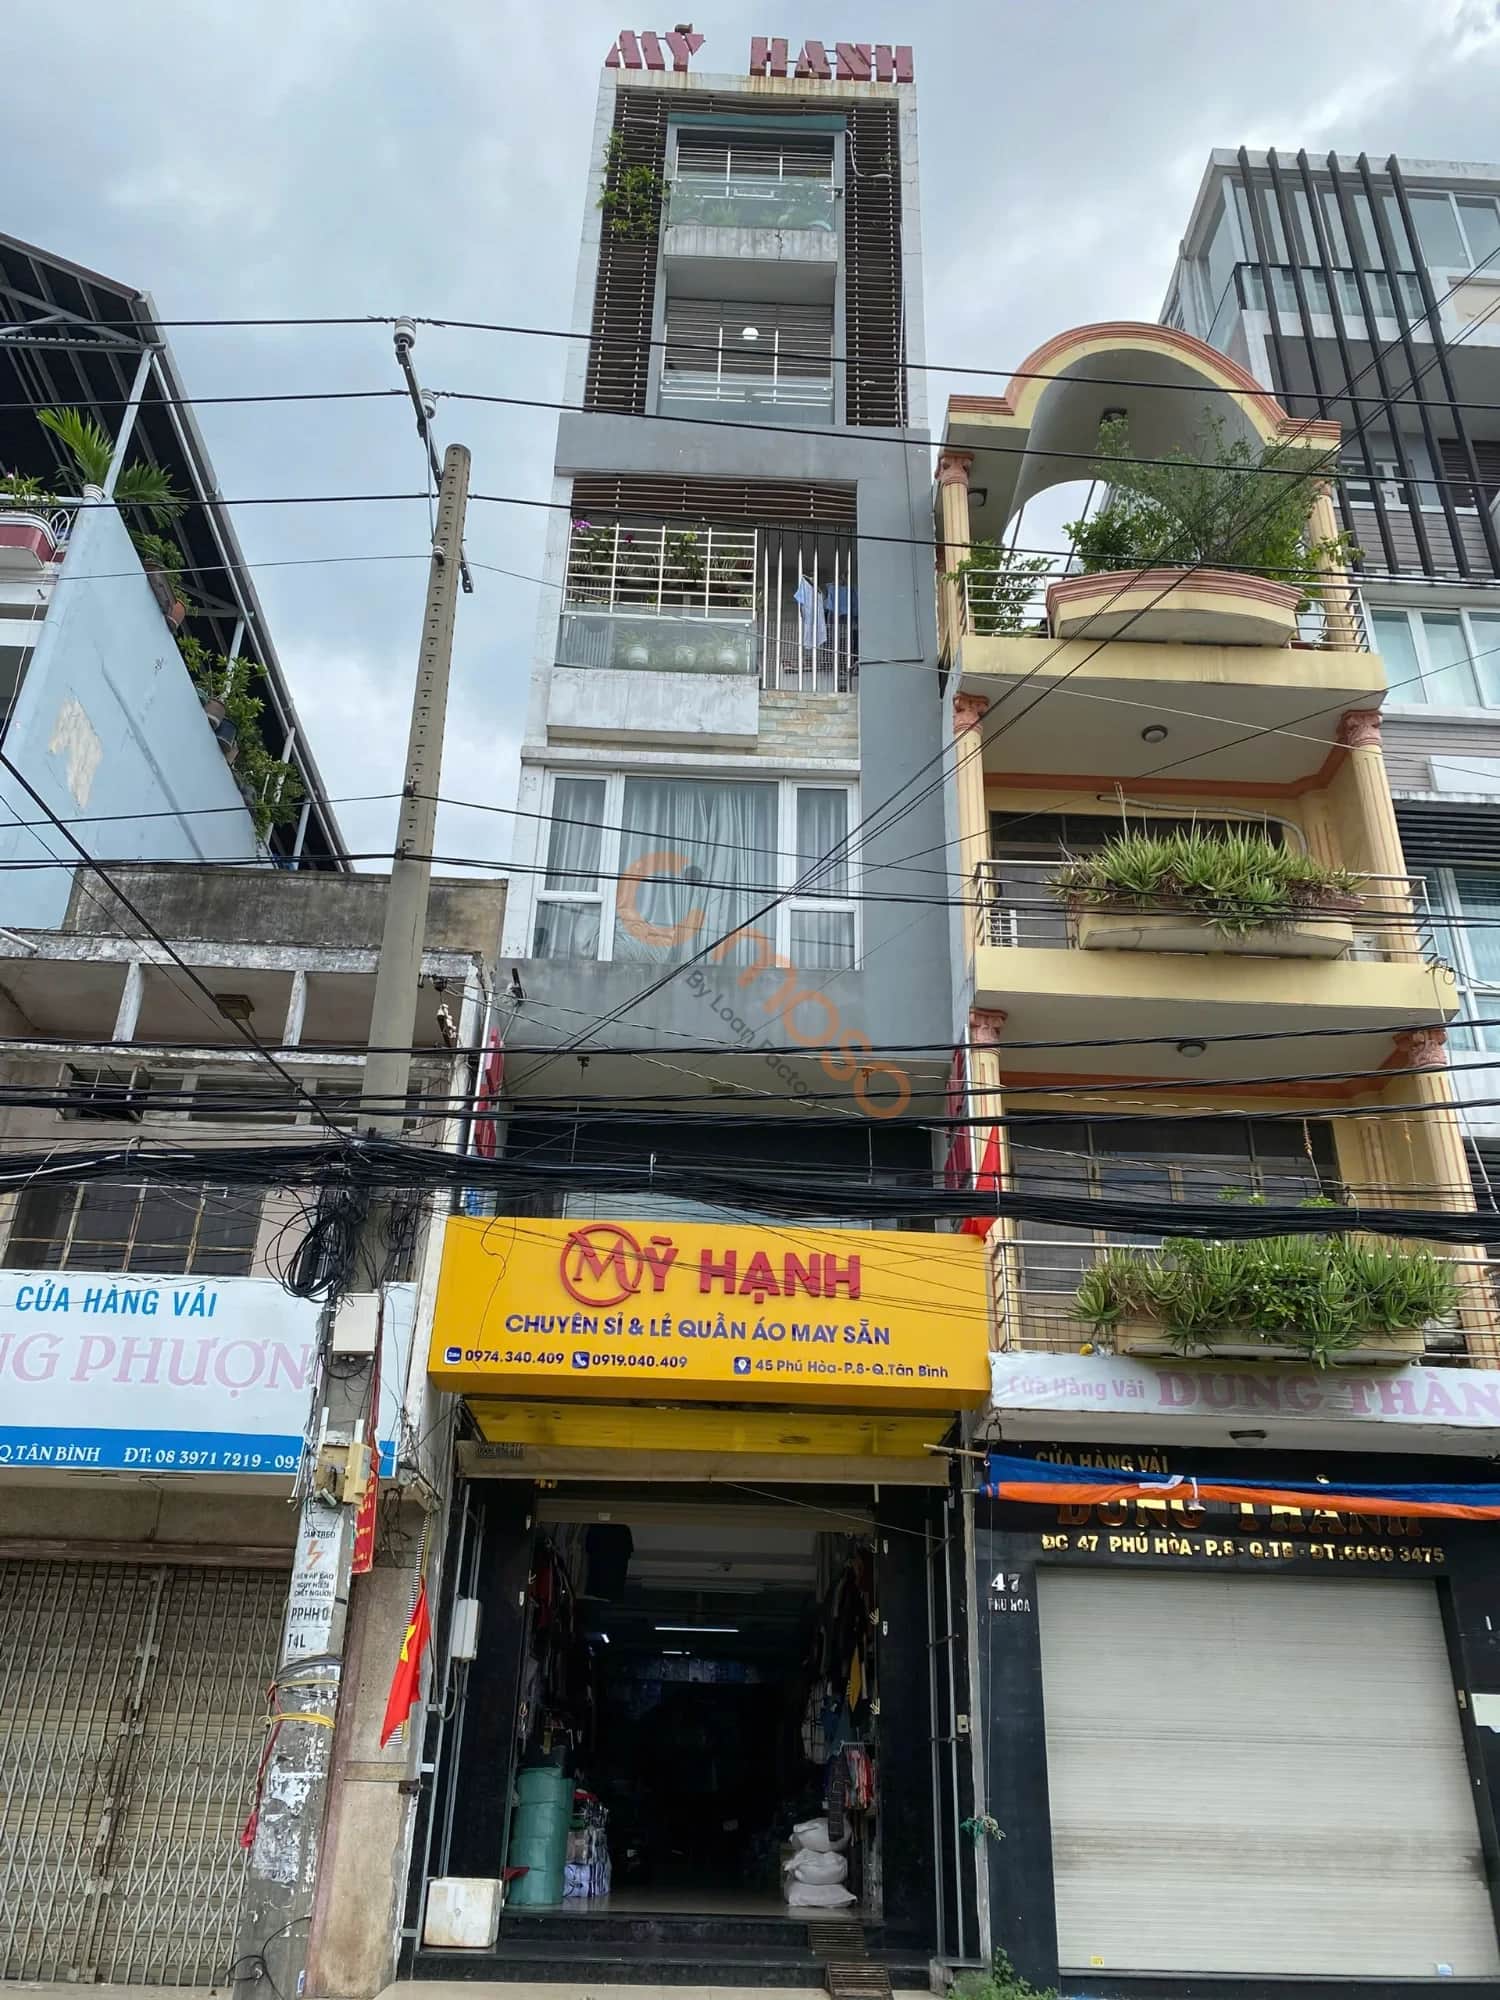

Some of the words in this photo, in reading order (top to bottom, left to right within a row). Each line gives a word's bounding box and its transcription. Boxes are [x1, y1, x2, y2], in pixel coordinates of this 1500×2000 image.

[562, 1226, 679, 1299] MỸ
[699, 1249, 861, 1304] HẠNH
[15, 1279, 70, 1313] CỬA
[83, 1284, 160, 1316] HÀNG
[173, 1285, 218, 1318] VẢI
[505, 1312, 598, 1335] CHUYÊN
[603, 1312, 624, 1336] SỈ
[627, 1317, 643, 1336] &
[649, 1312, 672, 1338] LẺ
[678, 1312, 746, 1340] QUẦN
[752, 1316, 786, 1342] ÁO
[791, 1323, 839, 1344] MAY
[843, 1318, 890, 1346] SẴN
[70, 1334, 316, 1398] PHƯỢN
[465, 1350, 564, 1364] 0974.340.409
[592, 1353, 688, 1368] 0919.040.409
[755, 1359, 773, 1372] 45
[777, 1359, 803, 1372] Phú
[919, 1364, 949, 1379] Bình
[1053, 1378, 1106, 1400] Hàng
[1112, 1379, 1145, 1399] Vải
[1156, 1371, 1322, 1411] DUNG
[55, 1443, 101, 1462] BÌNH
[123, 1446, 152, 1463] ĐT:
[155, 1449, 175, 1464] 08
[179, 1450, 217, 1466] 3971
[223, 1452, 260, 1468] 7219
[1042, 1534, 1069, 1550] ĐC
[1077, 1535, 1099, 1551] 47
[1109, 1532, 1149, 1554] PHÚ
[1399, 1547, 1445, 1563] 3475
[991, 1572, 1021, 1592] 47
